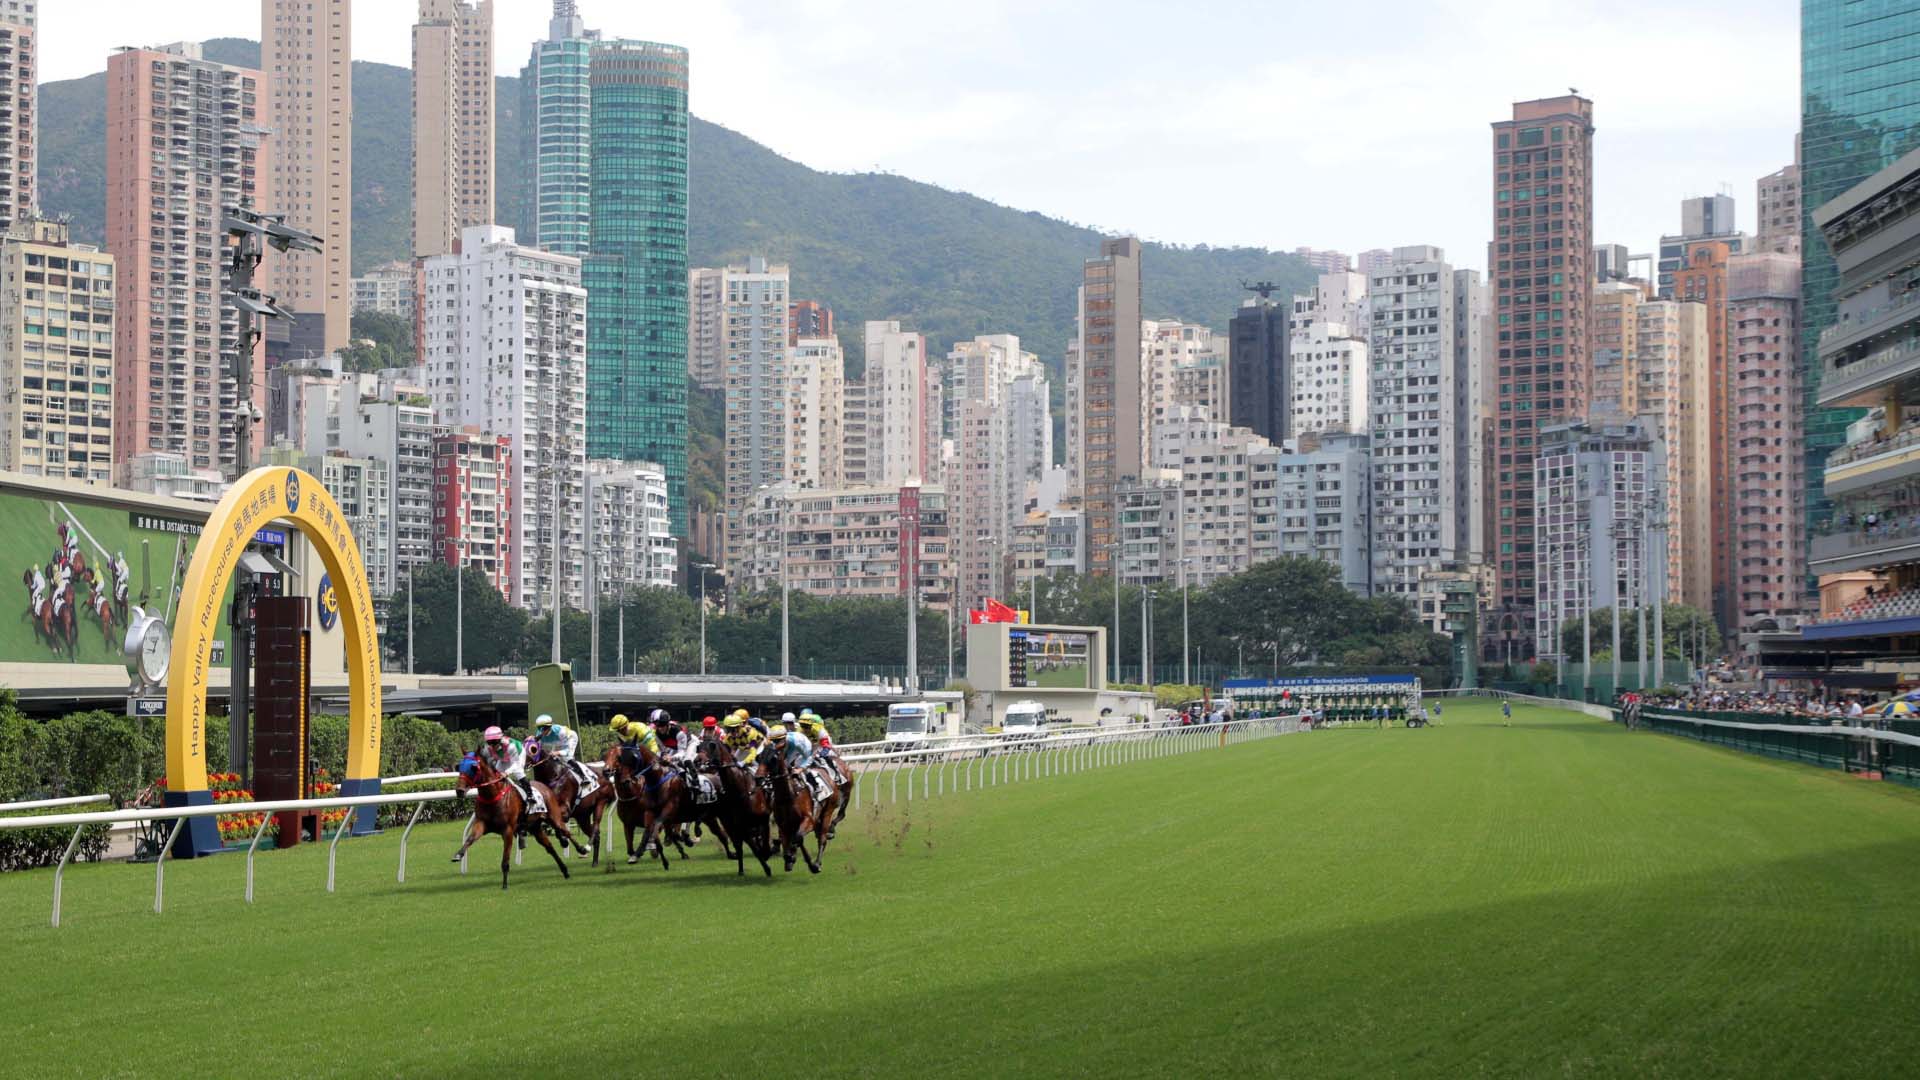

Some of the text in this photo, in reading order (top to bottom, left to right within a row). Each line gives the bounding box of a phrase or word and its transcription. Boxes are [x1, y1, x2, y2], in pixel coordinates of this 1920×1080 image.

[166, 521, 189, 533] DISTANCE
[190, 525, 197, 535] TO
[201, 537, 234, 628] Racecourse
[193, 633, 207, 687] Valley
[346, 548, 356, 575] The
[355, 574, 367, 613] Hong
[364, 613, 373, 653] Kong
[369, 655, 377, 709] Jockey
[191, 694, 201, 757] Happy
